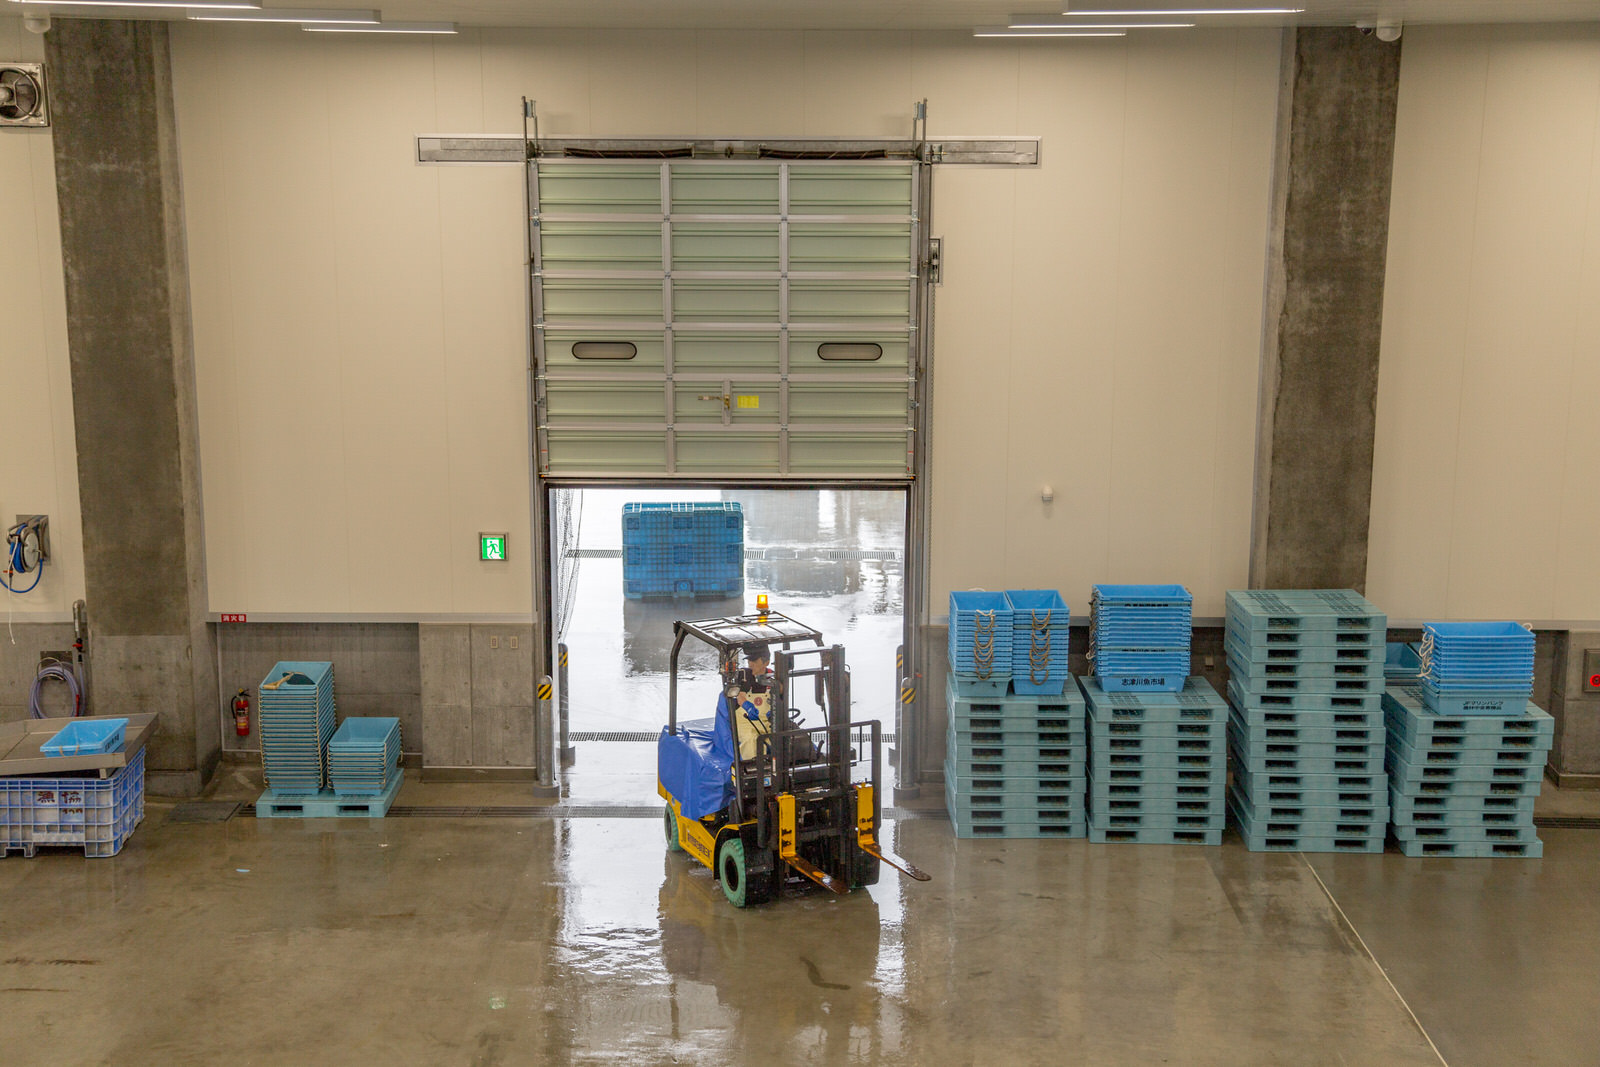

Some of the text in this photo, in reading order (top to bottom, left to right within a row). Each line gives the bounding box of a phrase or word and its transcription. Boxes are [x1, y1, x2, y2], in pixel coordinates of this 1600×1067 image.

[1121, 678, 1165, 686] 志津川魚市場
